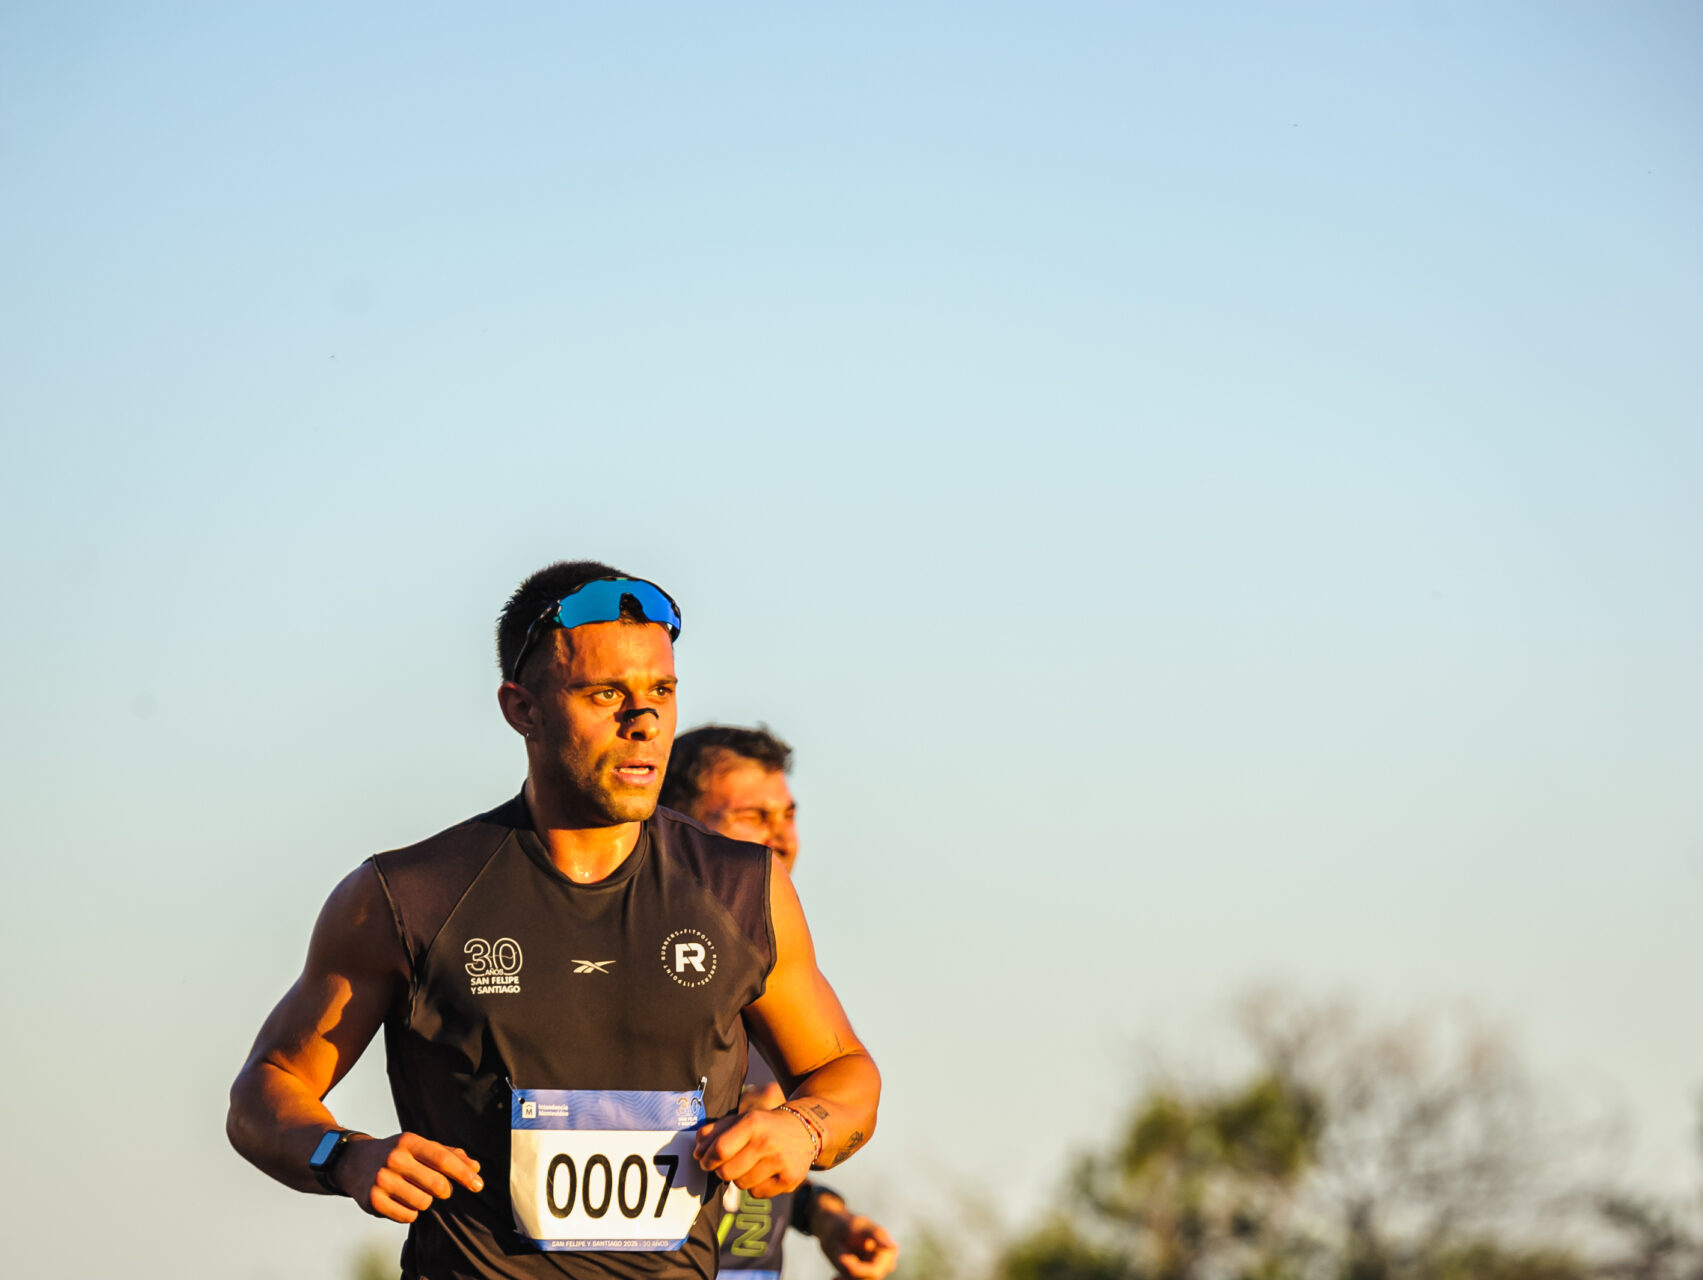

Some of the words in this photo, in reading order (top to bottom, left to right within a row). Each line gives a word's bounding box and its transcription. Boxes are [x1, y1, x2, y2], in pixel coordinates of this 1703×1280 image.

[464, 937, 523, 977] 30
[674, 942, 706, 973] R
[470, 977, 489, 986] SAN
[492, 976, 520, 985] FELIPE
[470, 986, 477, 995] Y
[477, 985, 521, 994] SANTIAGO
[546, 1153, 679, 1219] 0007
